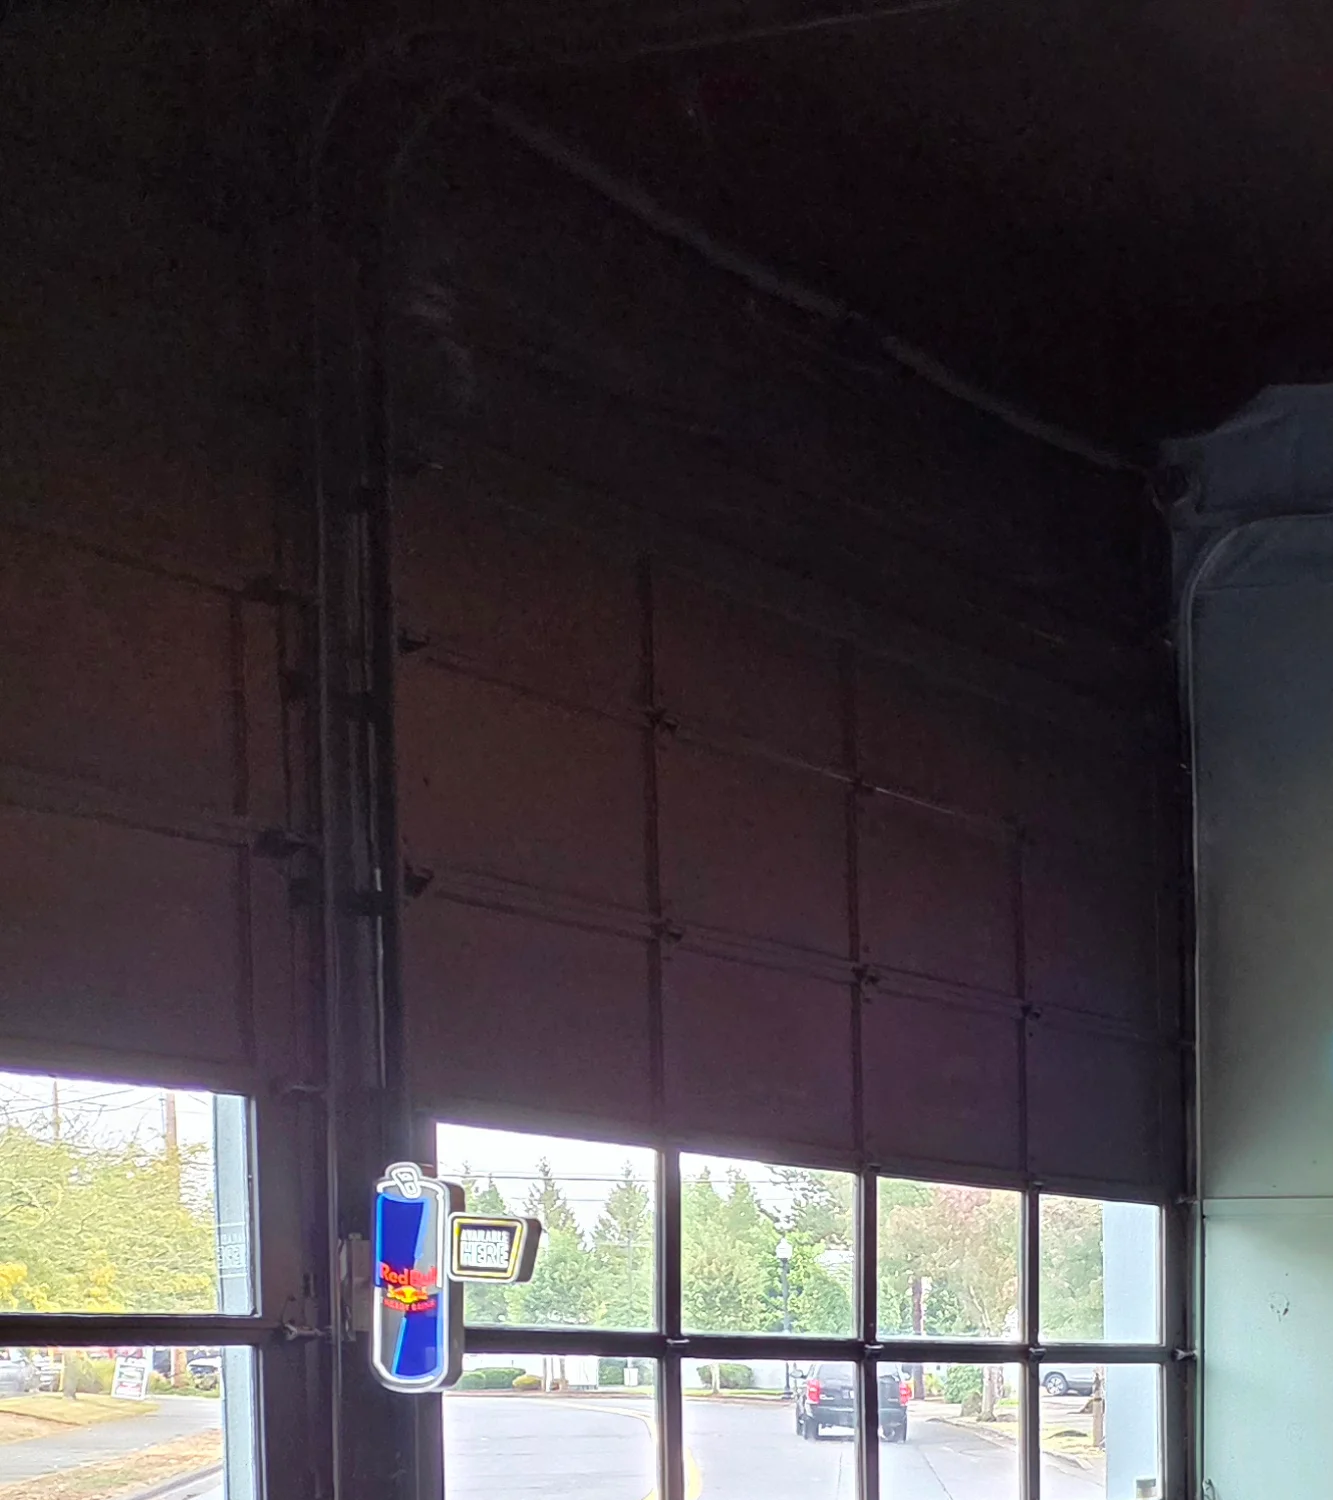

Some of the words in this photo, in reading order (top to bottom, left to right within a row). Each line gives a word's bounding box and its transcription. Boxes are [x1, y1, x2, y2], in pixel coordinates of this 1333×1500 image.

[460, 1229, 510, 1243] AVAILABLE
[460, 1241, 509, 1268] HERE
[380, 1263, 409, 1286] Red
